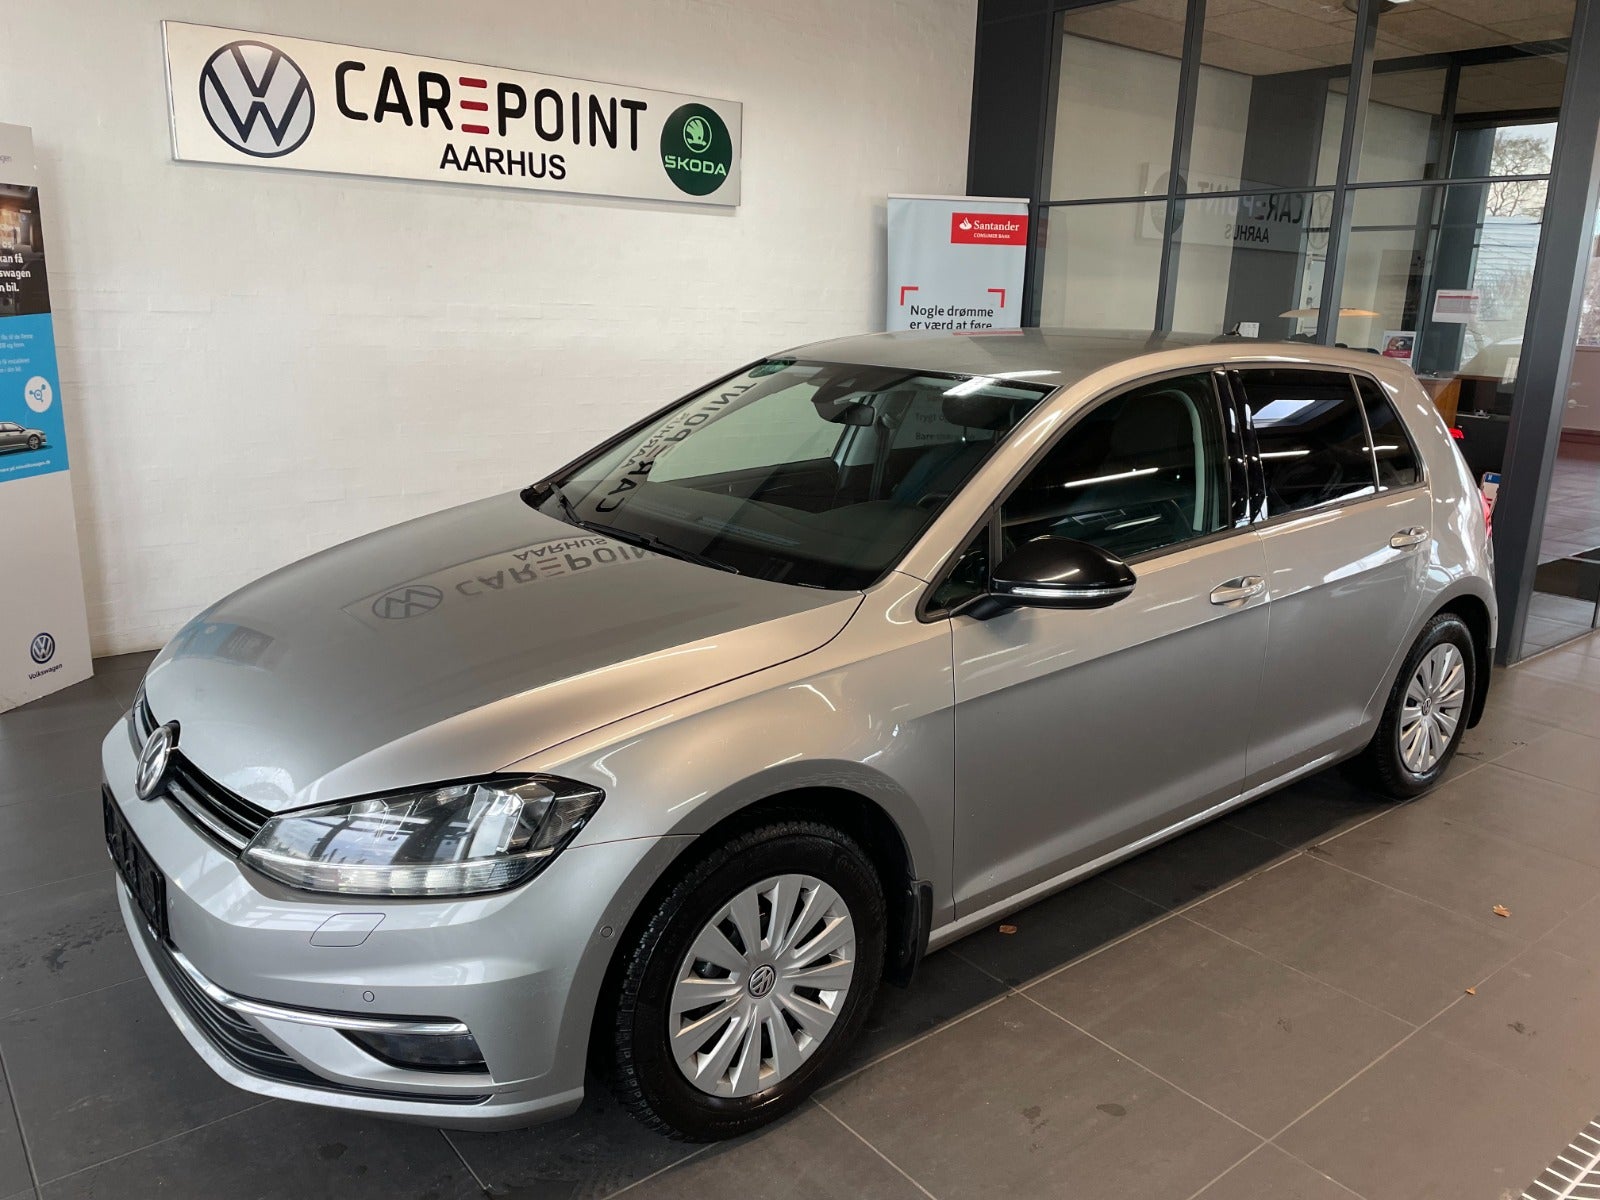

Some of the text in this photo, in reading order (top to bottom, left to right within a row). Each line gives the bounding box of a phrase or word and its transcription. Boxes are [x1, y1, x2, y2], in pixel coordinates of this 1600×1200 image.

[440, 143, 567, 180] AARHUS
[973, 220, 1020, 231] Santander
[6, 282, 20, 292] bil.
[910, 305, 994, 319] Nogle drømme
[909, 321, 922, 330] er
[924, 320, 954, 330] værd
[956, 322, 967, 330] at
[28, 663, 63, 680] Volkswagen
